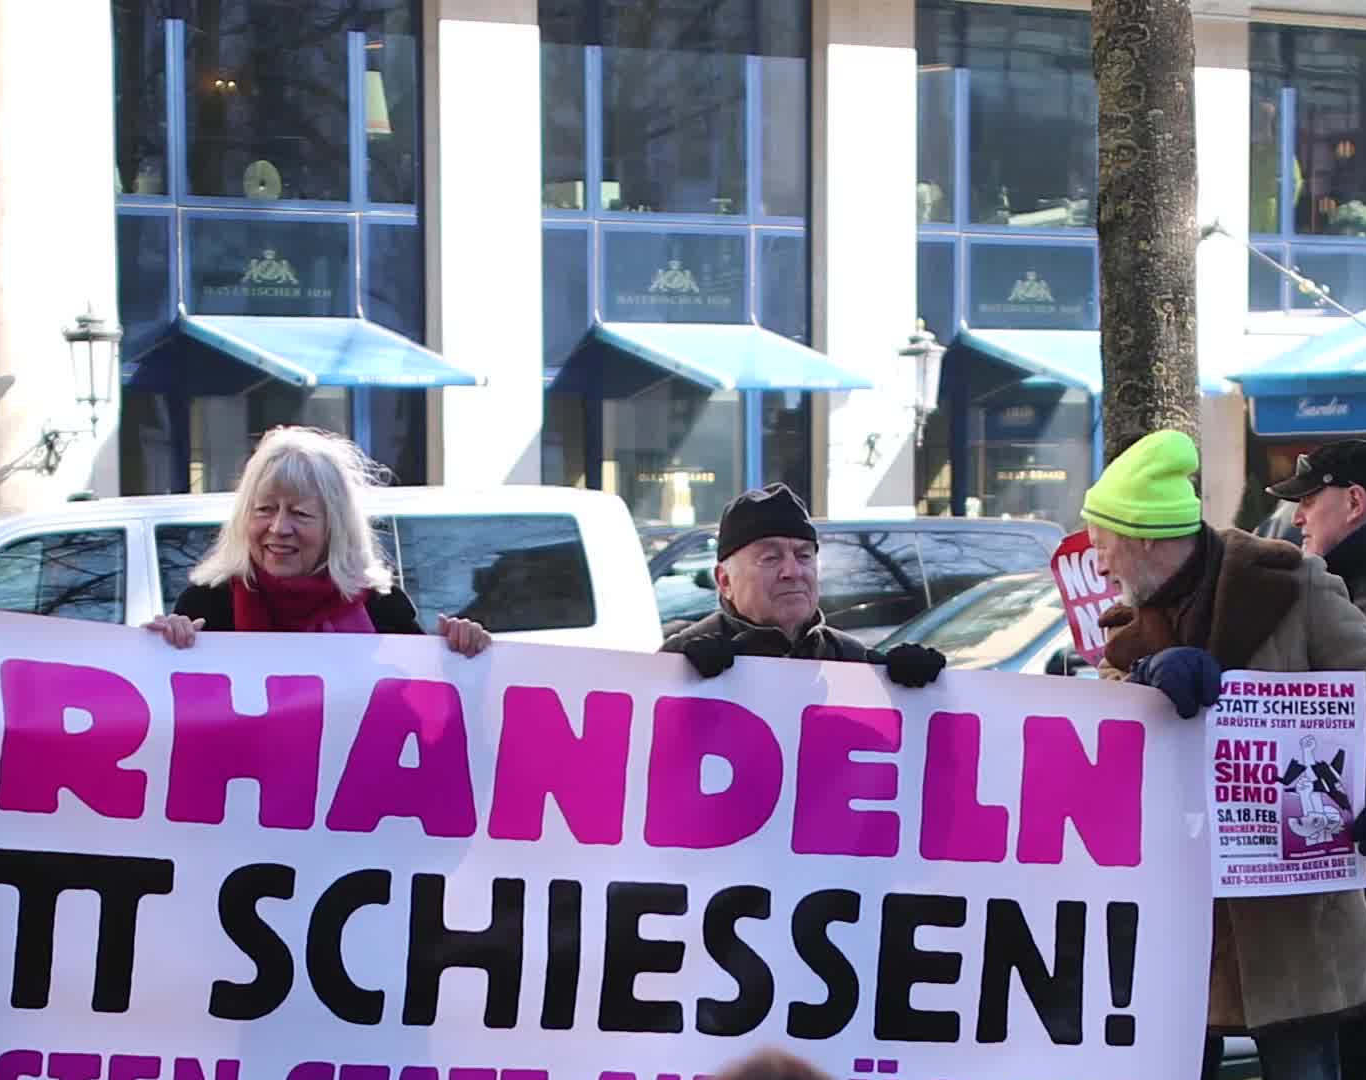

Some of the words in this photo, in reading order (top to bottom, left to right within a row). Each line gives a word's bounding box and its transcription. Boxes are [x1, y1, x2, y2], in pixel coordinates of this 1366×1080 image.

[1218, 681, 1356, 698] VERHANDELN
[1216, 699, 1258, 714] STATT
[1263, 701, 1356, 716] SCHIESSEN!
[1215, 717, 1267, 728] ABRÜSTEN
[1271, 718, 1297, 729] STATT
[1300, 718, 1356, 730] AUFRÜSTEN
[1214, 739, 1278, 762] ANTI
[1214, 762, 1279, 785] SIKO
[1215, 784, 1278, 805] DEMO
[208, 862, 1139, 1047] SCHIESSEN!
